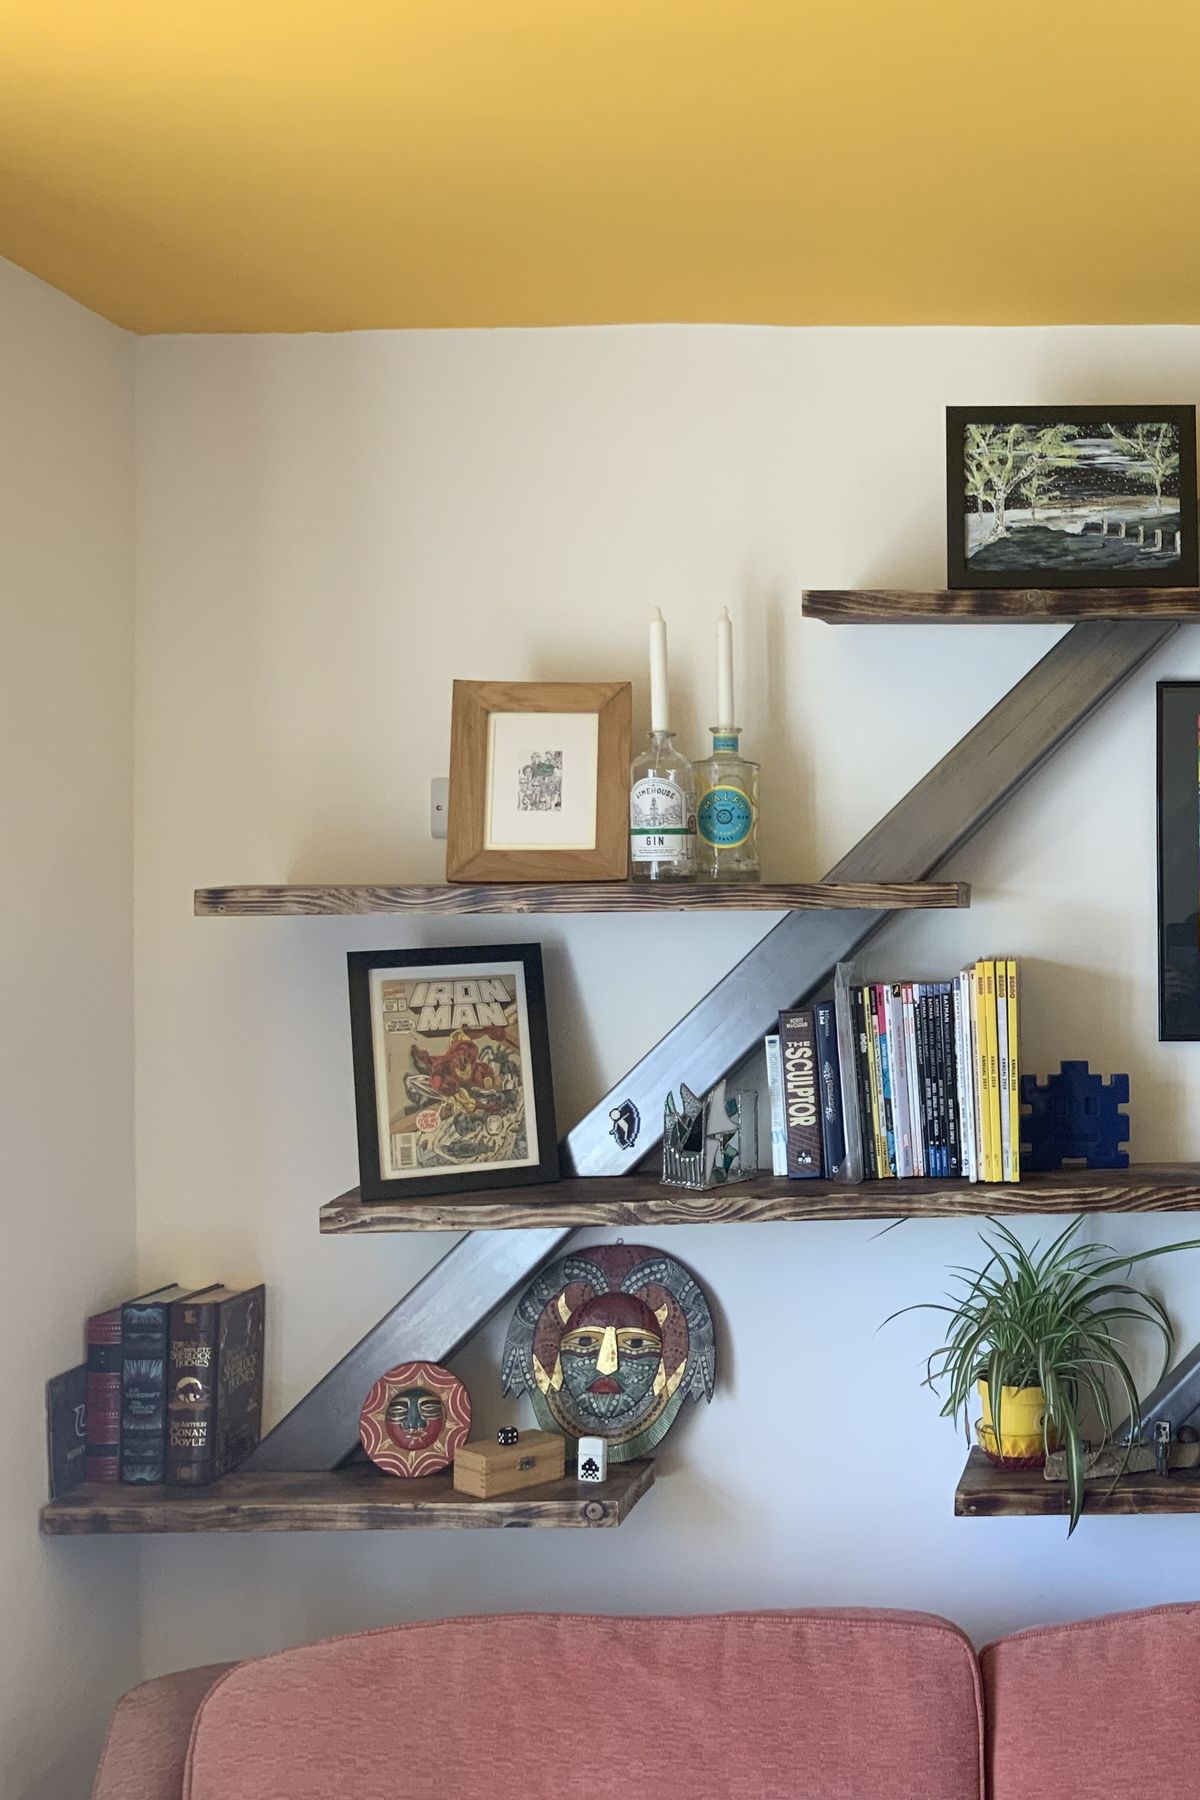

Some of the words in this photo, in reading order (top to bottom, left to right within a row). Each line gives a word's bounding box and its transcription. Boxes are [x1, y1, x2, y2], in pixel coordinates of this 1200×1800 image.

[703, 791, 748, 810] MALFY
[646, 836, 665, 846] GIN
[409, 978, 512, 1010] IRON
[416, 1001, 509, 1033] MAN
[786, 1040, 811, 1048] THE
[785, 1046, 816, 1127] SCULPTOR
[170, 1428, 207, 1437] CONAN
[170, 1437, 207, 1447] DOYLE
